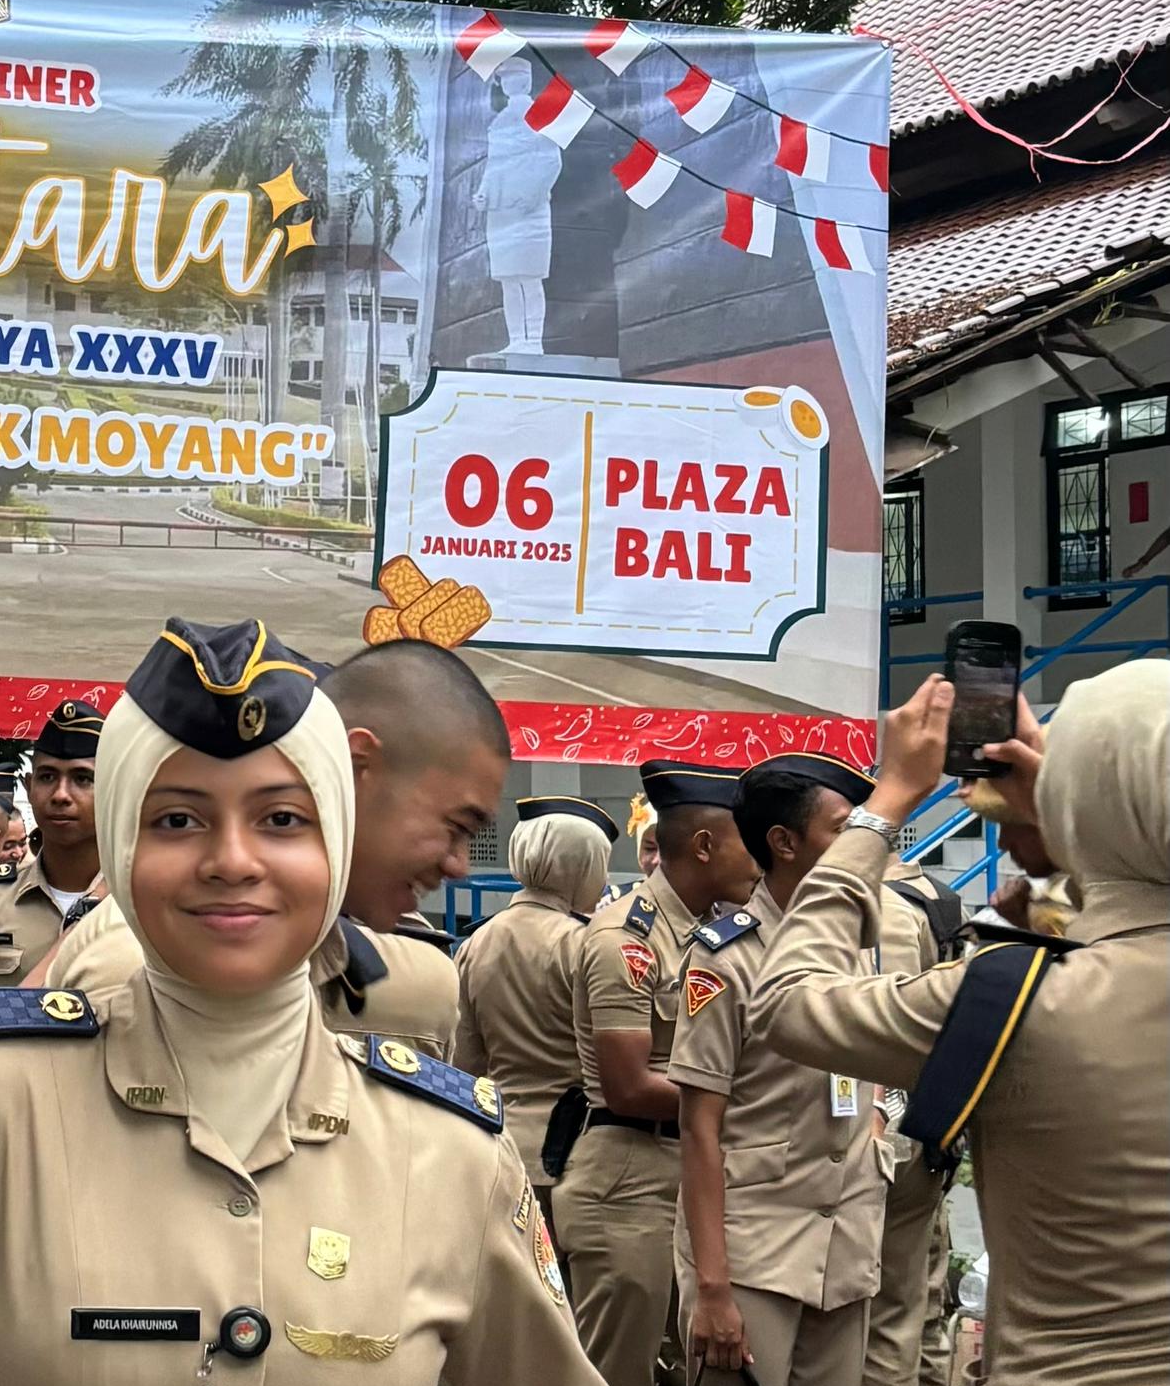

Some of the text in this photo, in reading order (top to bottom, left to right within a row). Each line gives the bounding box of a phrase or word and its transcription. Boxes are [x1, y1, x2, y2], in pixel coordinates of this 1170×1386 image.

[76, 331, 218, 380] XXXV
[38, 417, 328, 478] MOYANG"
[444, 453, 554, 531] 06
[605, 458, 790, 516] PLAZA
[420, 535, 572, 562] JANUARI 2025
[615, 528, 752, 583] BALI
[92, 1318, 120, 1330] ADELA
